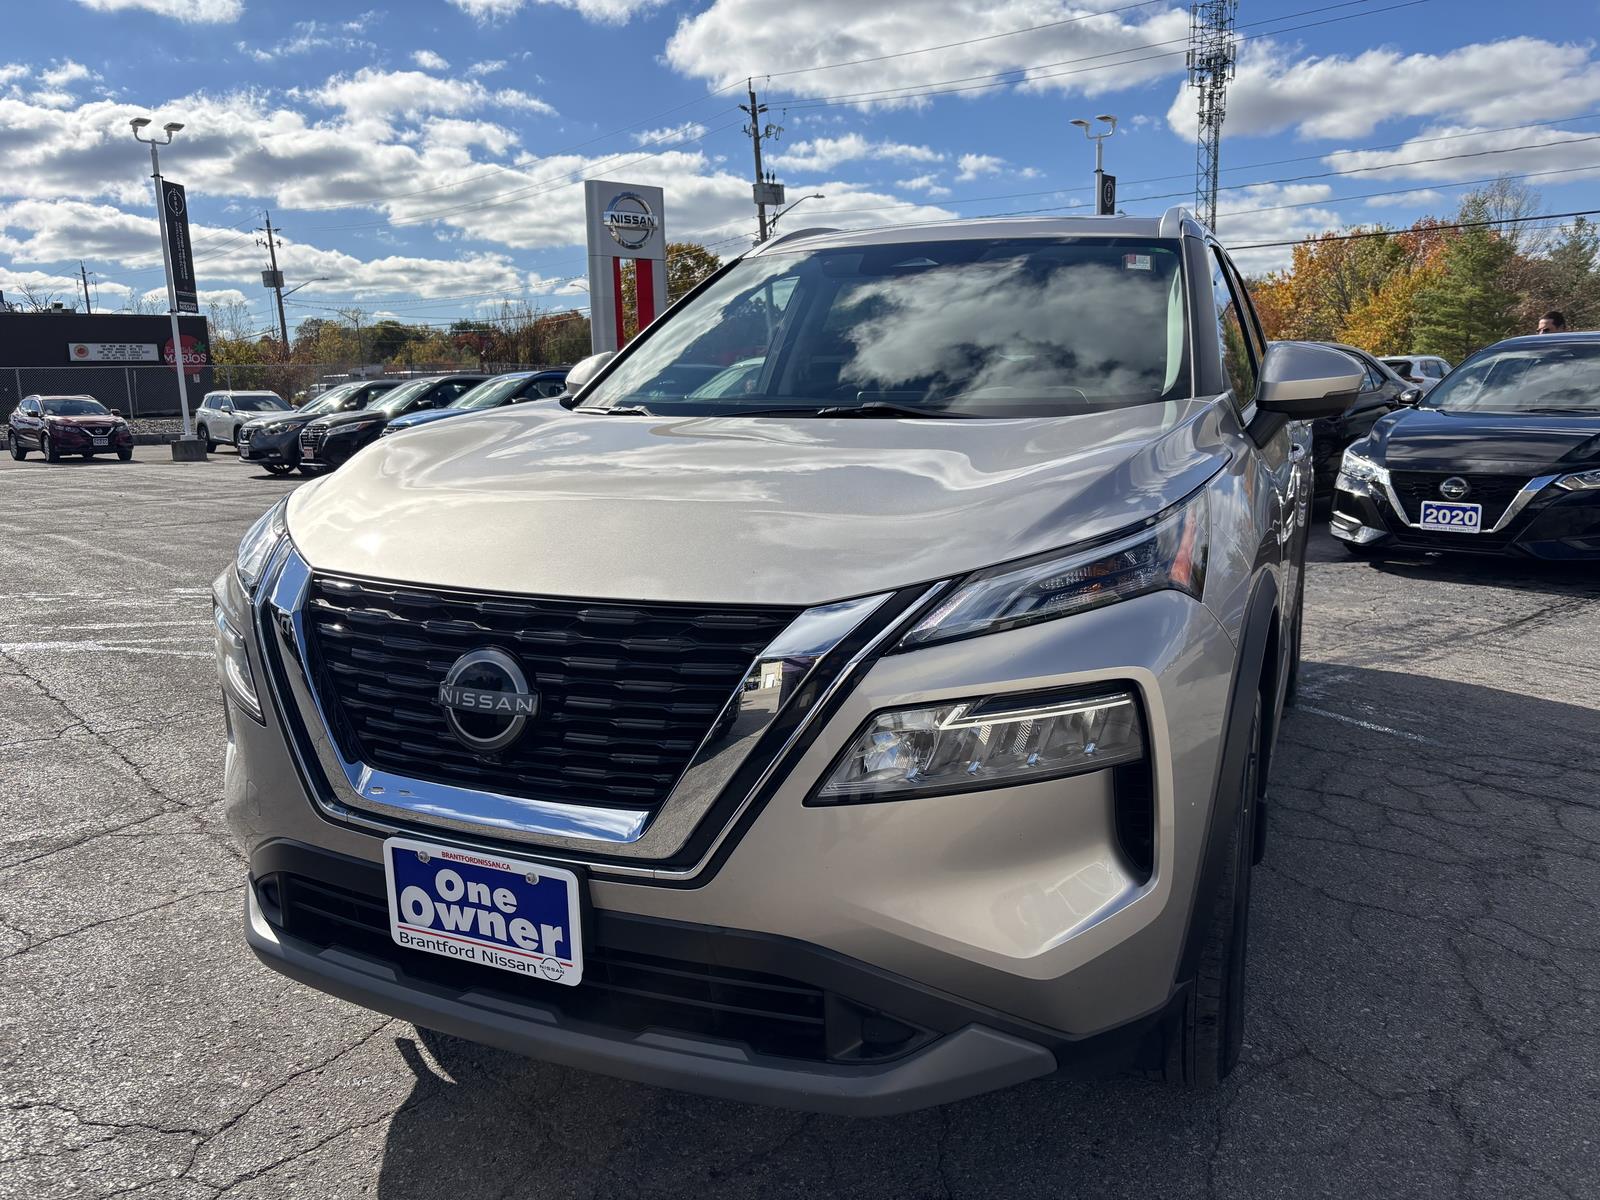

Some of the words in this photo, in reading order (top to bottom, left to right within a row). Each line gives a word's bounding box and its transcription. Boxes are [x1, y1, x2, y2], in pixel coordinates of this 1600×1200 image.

[610, 214, 655, 227] NISSAN
[1424, 508, 1478, 526] 2020
[440, 687, 533, 713] NISSAN
[441, 850, 512, 871] BRANTFORDNISSAN.CA
[435, 868, 518, 914] One
[400, 885, 563, 957] Owner
[400, 931, 475, 959] Brantford
[482, 950, 537, 974] Nissan
[539, 964, 565, 975] NISSAN
